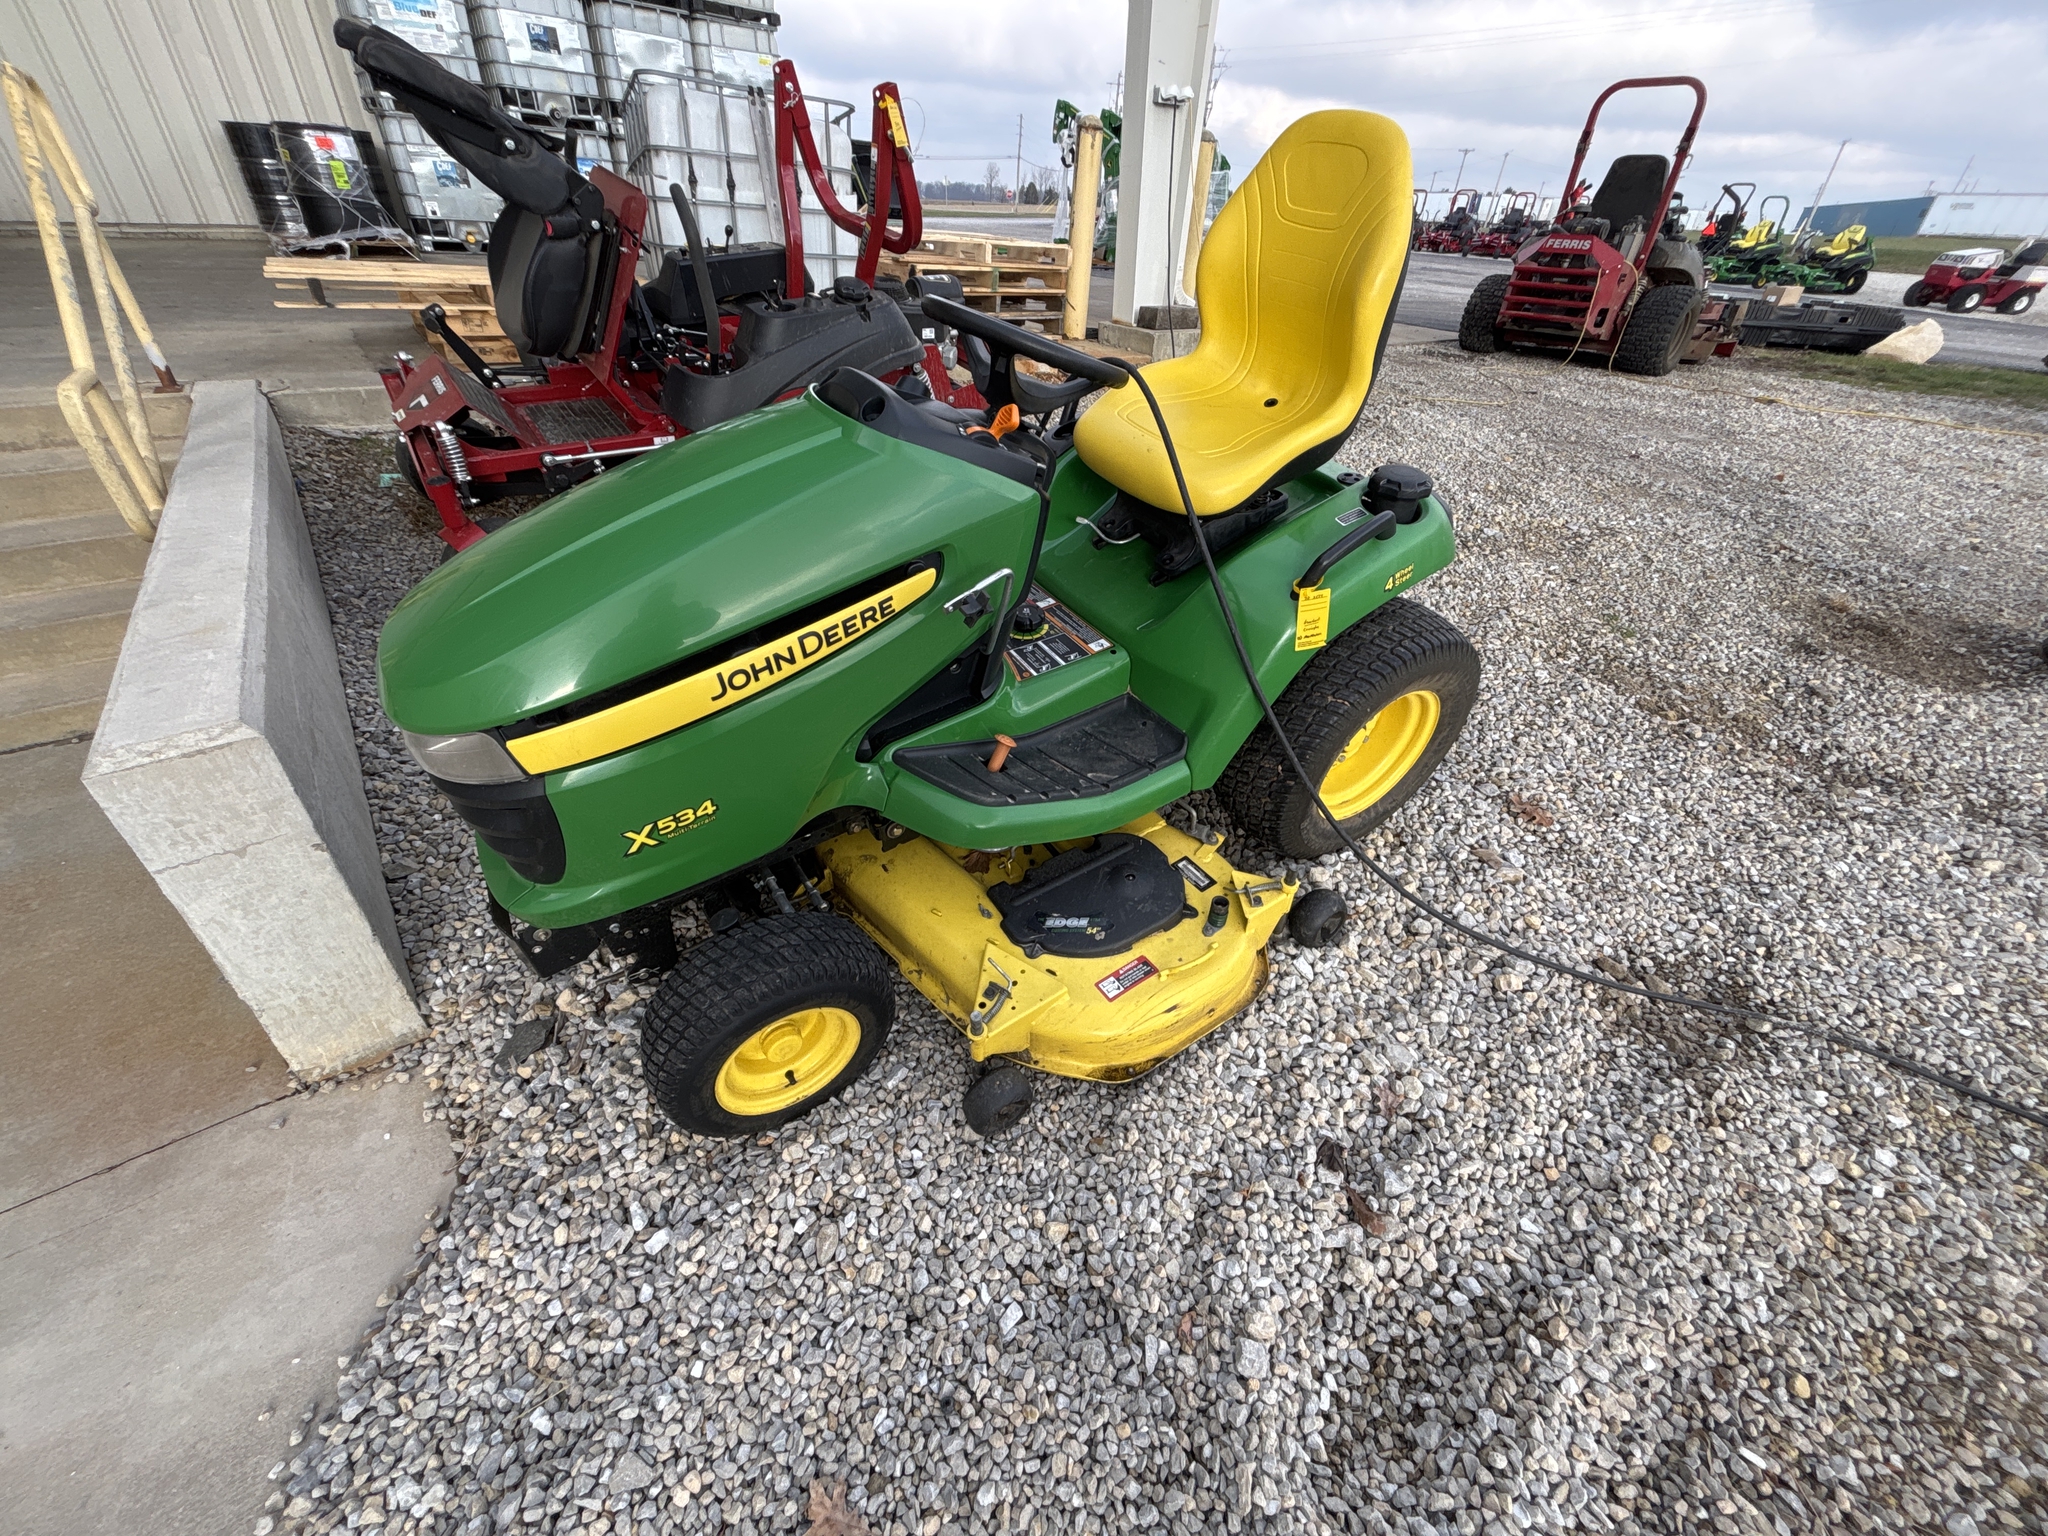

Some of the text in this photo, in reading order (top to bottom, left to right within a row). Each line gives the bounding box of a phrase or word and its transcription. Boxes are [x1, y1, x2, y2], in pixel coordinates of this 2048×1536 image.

[1545, 238, 1592, 250] FERRIS
[1384, 562, 1415, 591] 4 Wheel
[1394, 571, 1414, 587] Steer
[710, 595, 896, 702] JOHN DEERE
[621, 799, 718, 855] X534
[1043, 916, 1090, 928] EDGE
